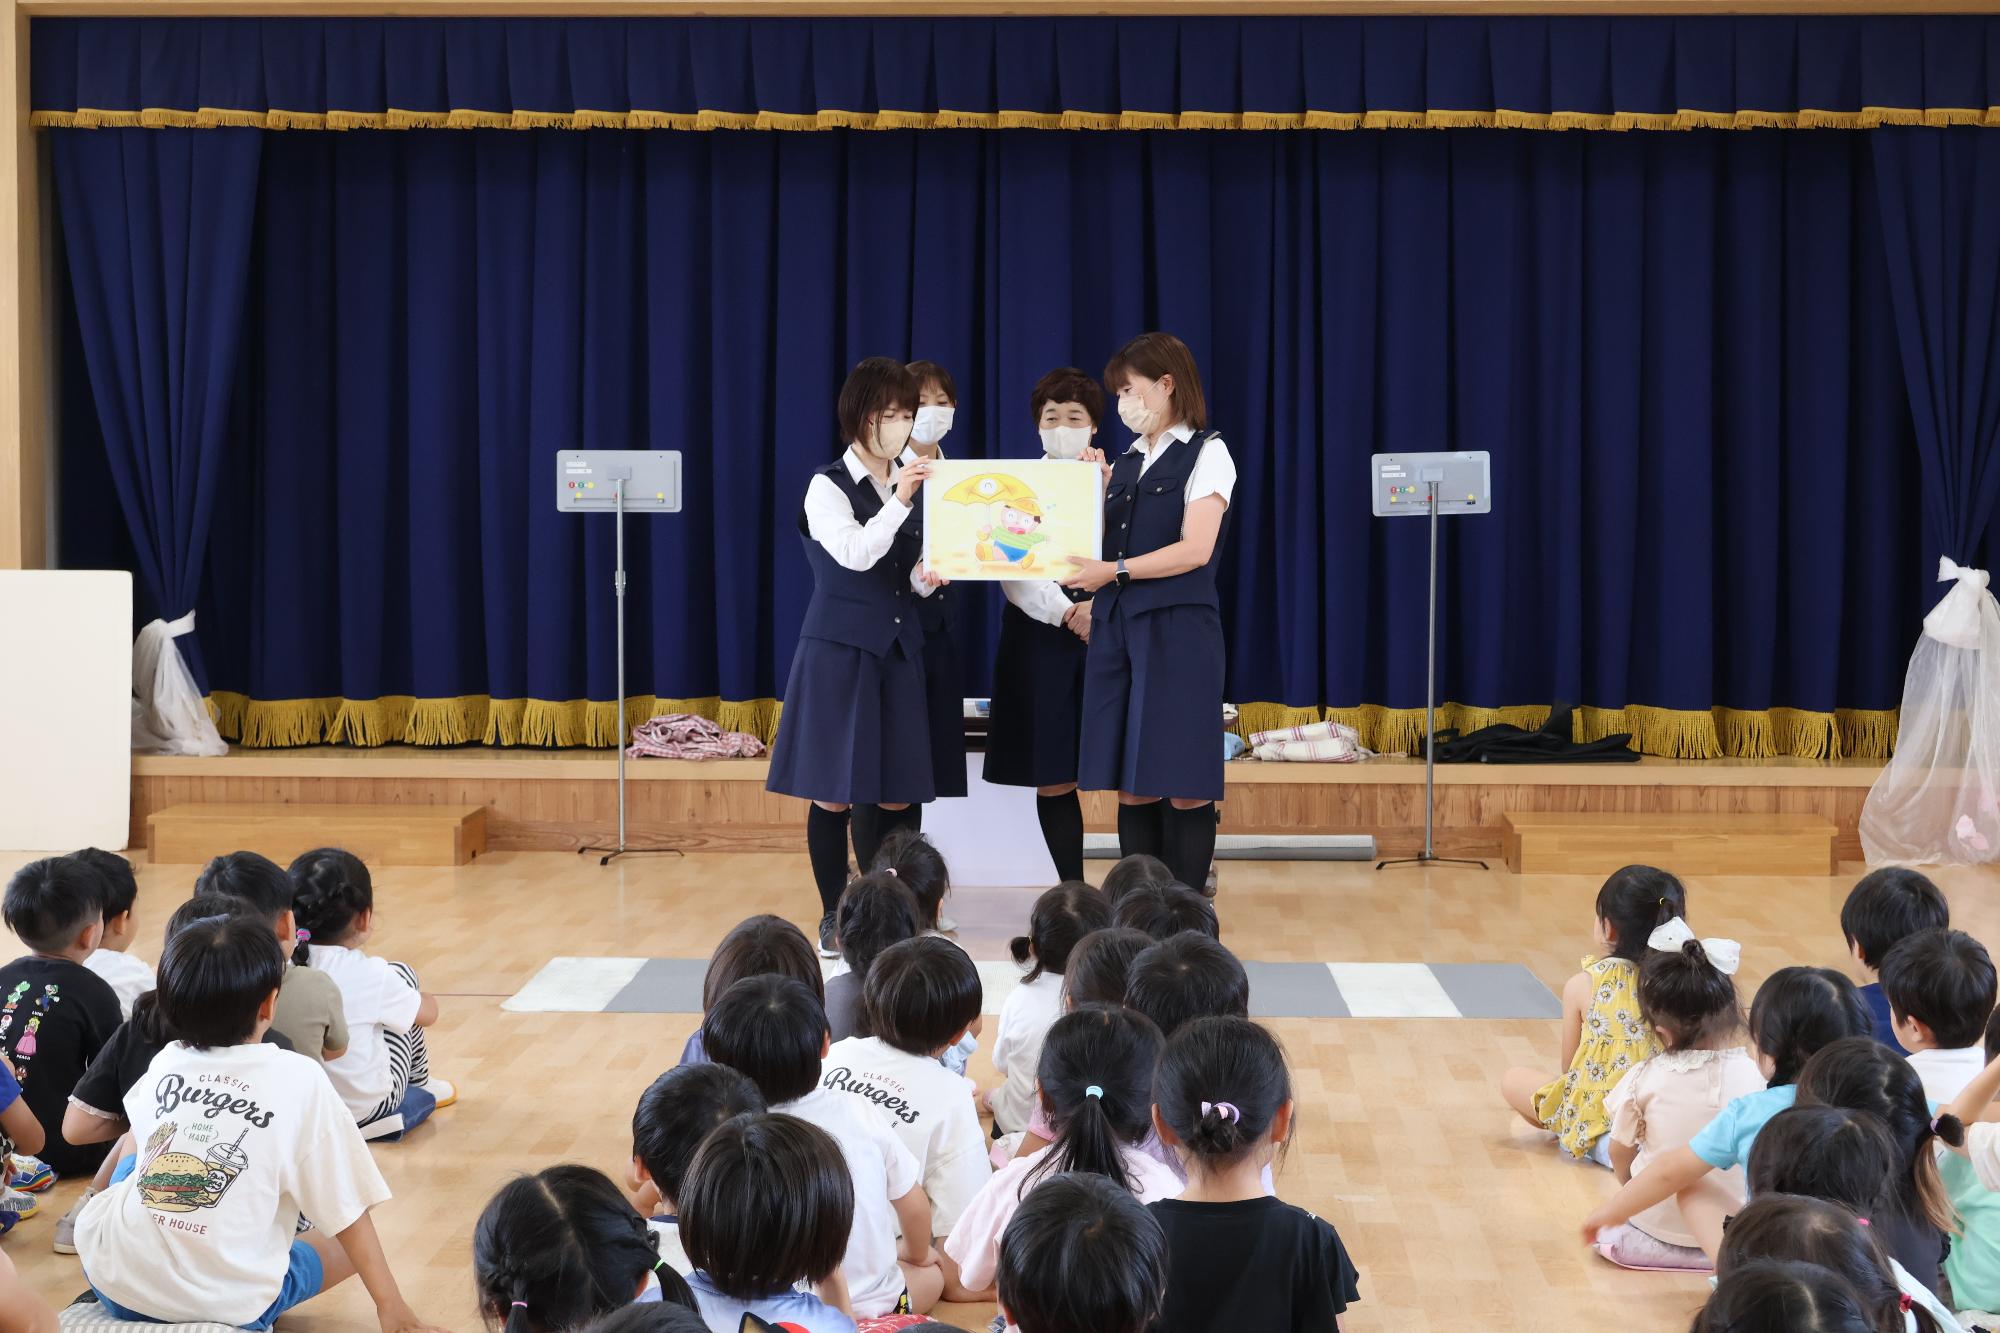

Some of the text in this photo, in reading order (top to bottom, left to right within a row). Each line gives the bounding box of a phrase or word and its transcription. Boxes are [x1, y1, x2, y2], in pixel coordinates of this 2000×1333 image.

[199, 1074, 250, 1092] CLASSIC
[863, 1072, 905, 1094] CLASSIC
[155, 1073, 275, 1129] Burgers
[191, 1122, 214, 1133] HOME
[188, 1134, 210, 1143] MADE
[152, 1213, 208, 1235] ER HOUSE
